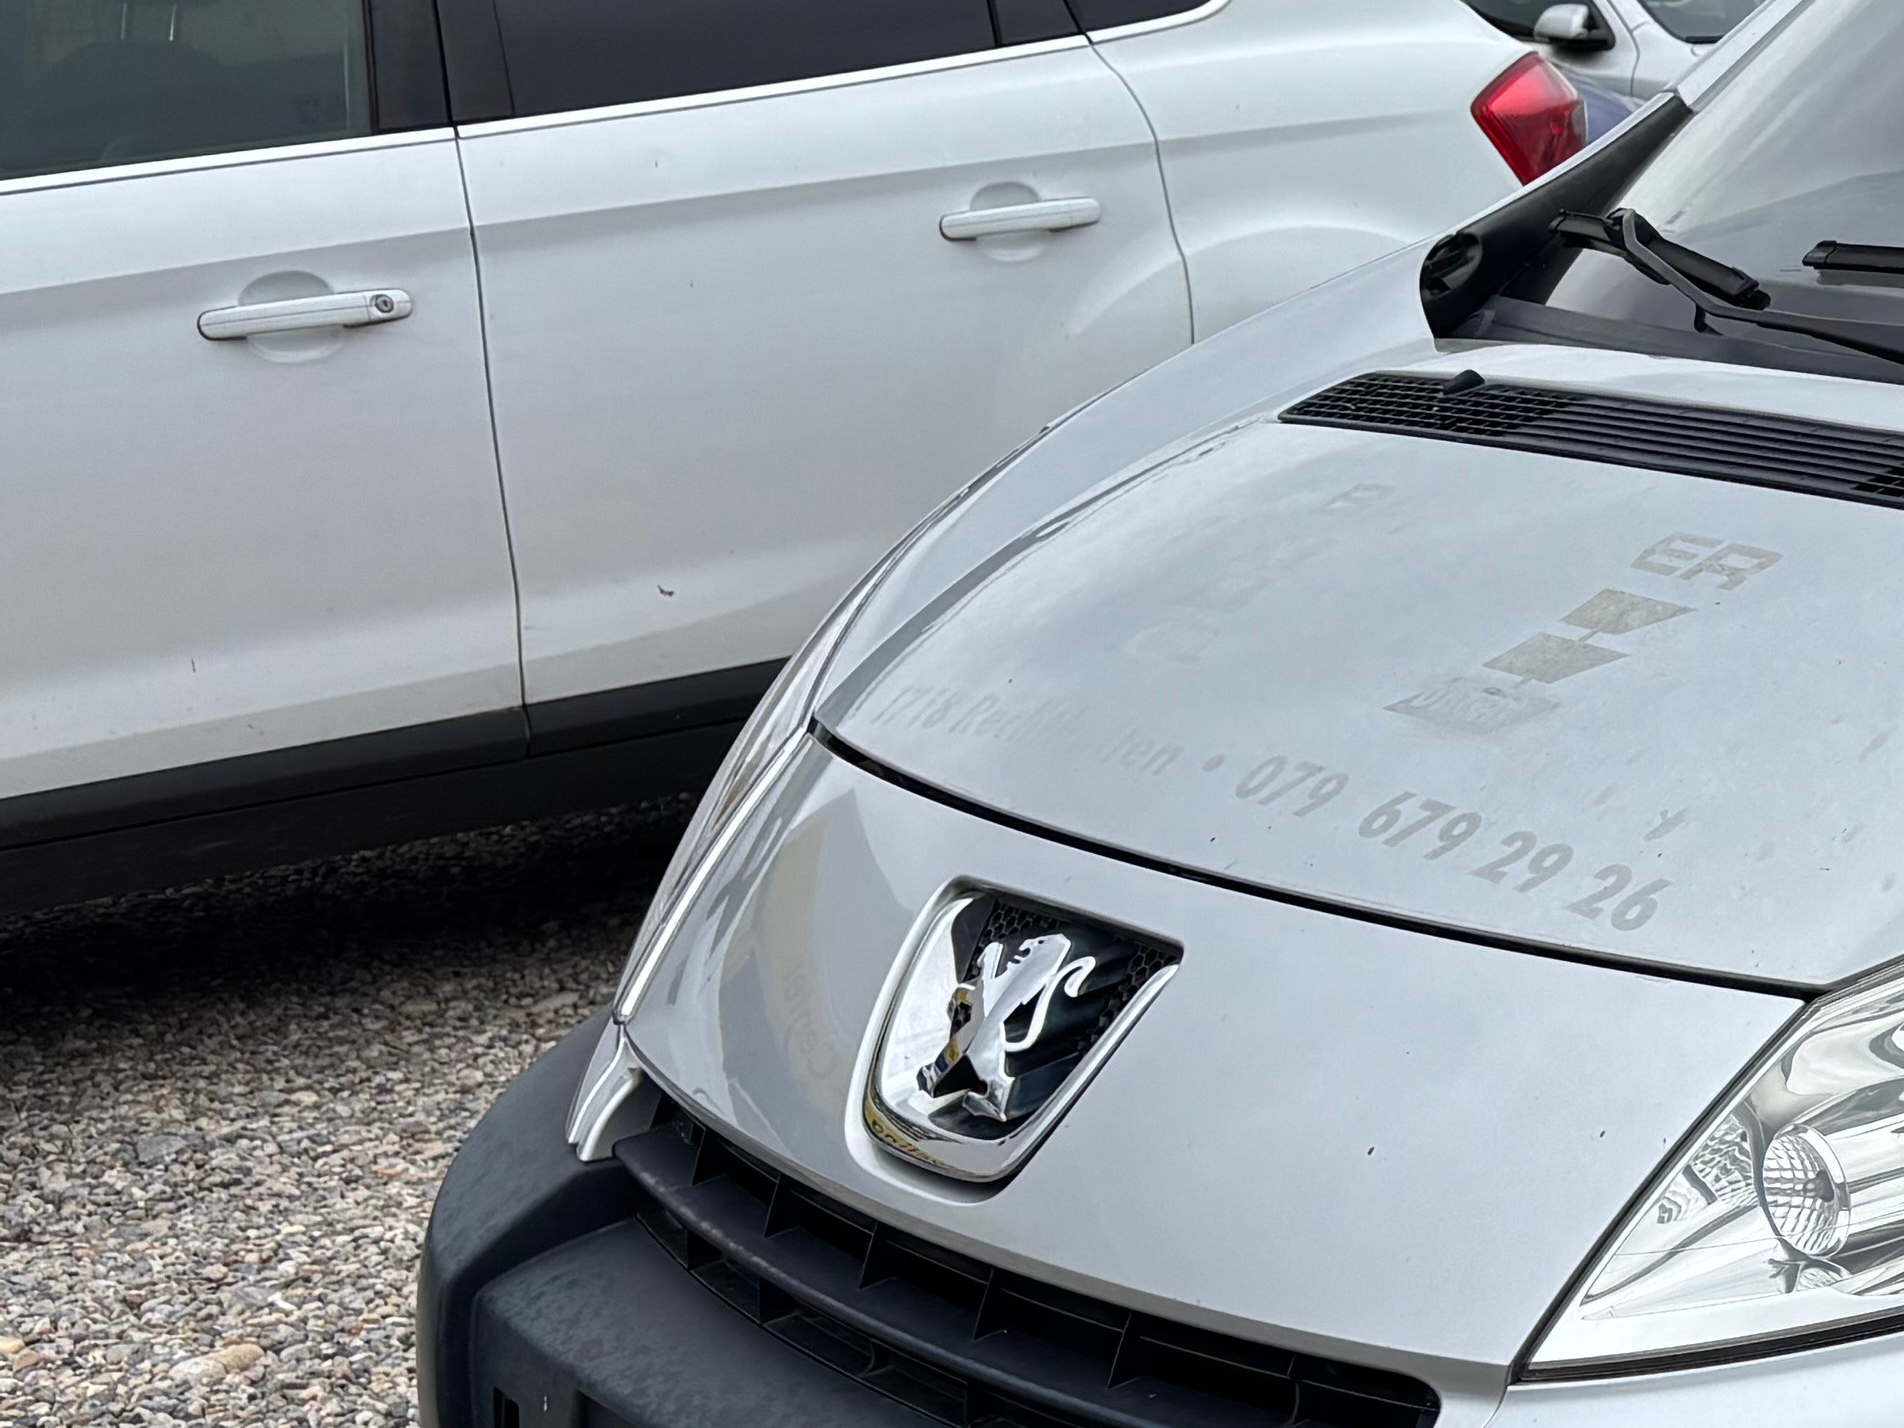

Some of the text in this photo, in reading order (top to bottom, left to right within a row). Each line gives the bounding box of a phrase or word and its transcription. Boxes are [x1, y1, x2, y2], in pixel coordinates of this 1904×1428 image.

[1235, 755, 1349, 818] 079
[1357, 791, 1482, 861] 679
[1470, 830, 1574, 893] 29
[1566, 863, 1673, 931] 26
